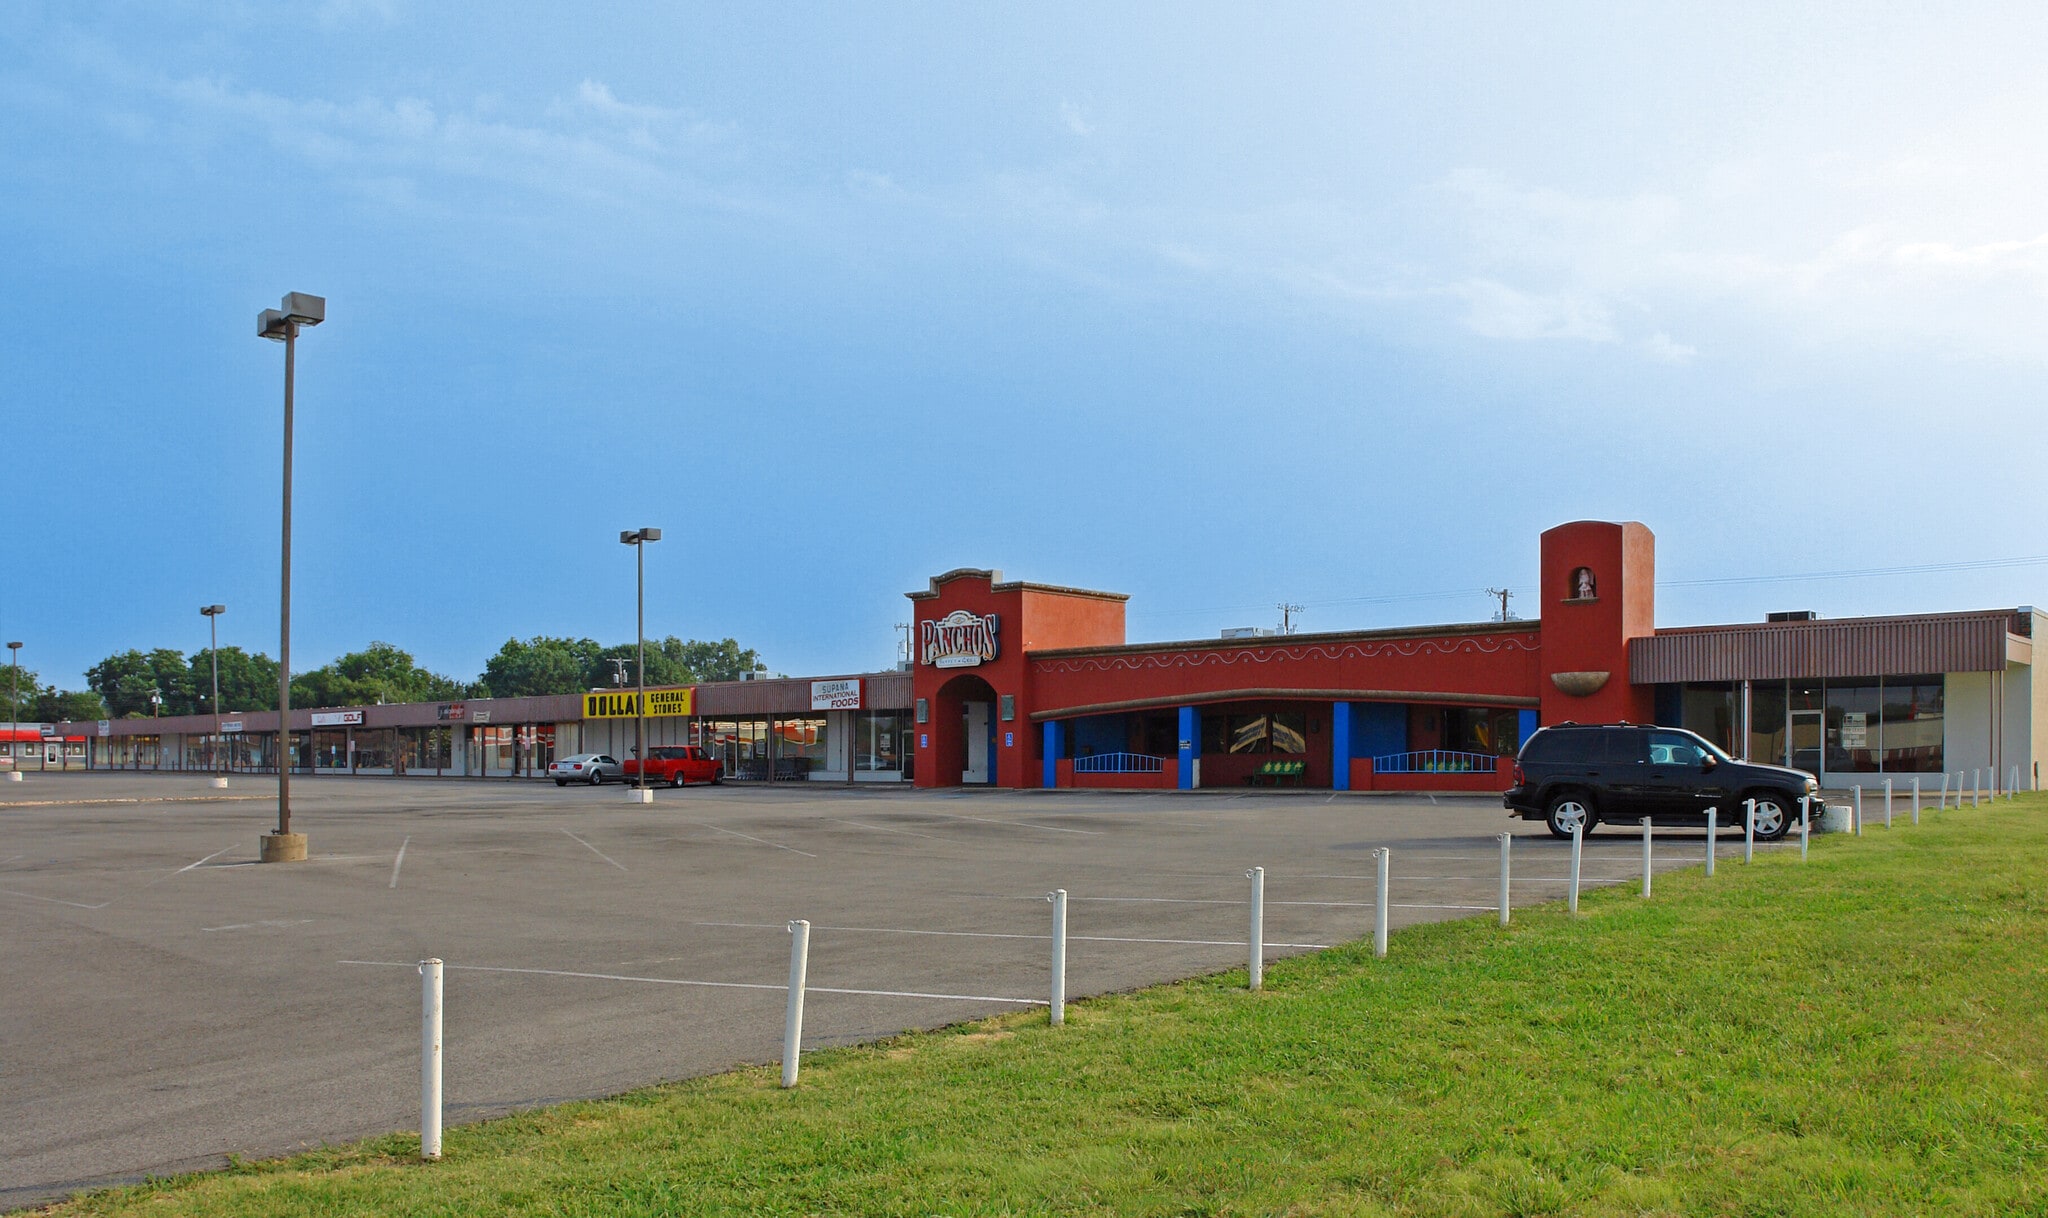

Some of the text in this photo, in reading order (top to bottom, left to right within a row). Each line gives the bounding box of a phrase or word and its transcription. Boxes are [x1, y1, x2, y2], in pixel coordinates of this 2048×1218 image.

[650, 692, 684, 703] GENERAL
[813, 690, 858, 702] INTERNATIONAL
[831, 697, 859, 708] FOODS
[653, 704, 682, 714] STORES
